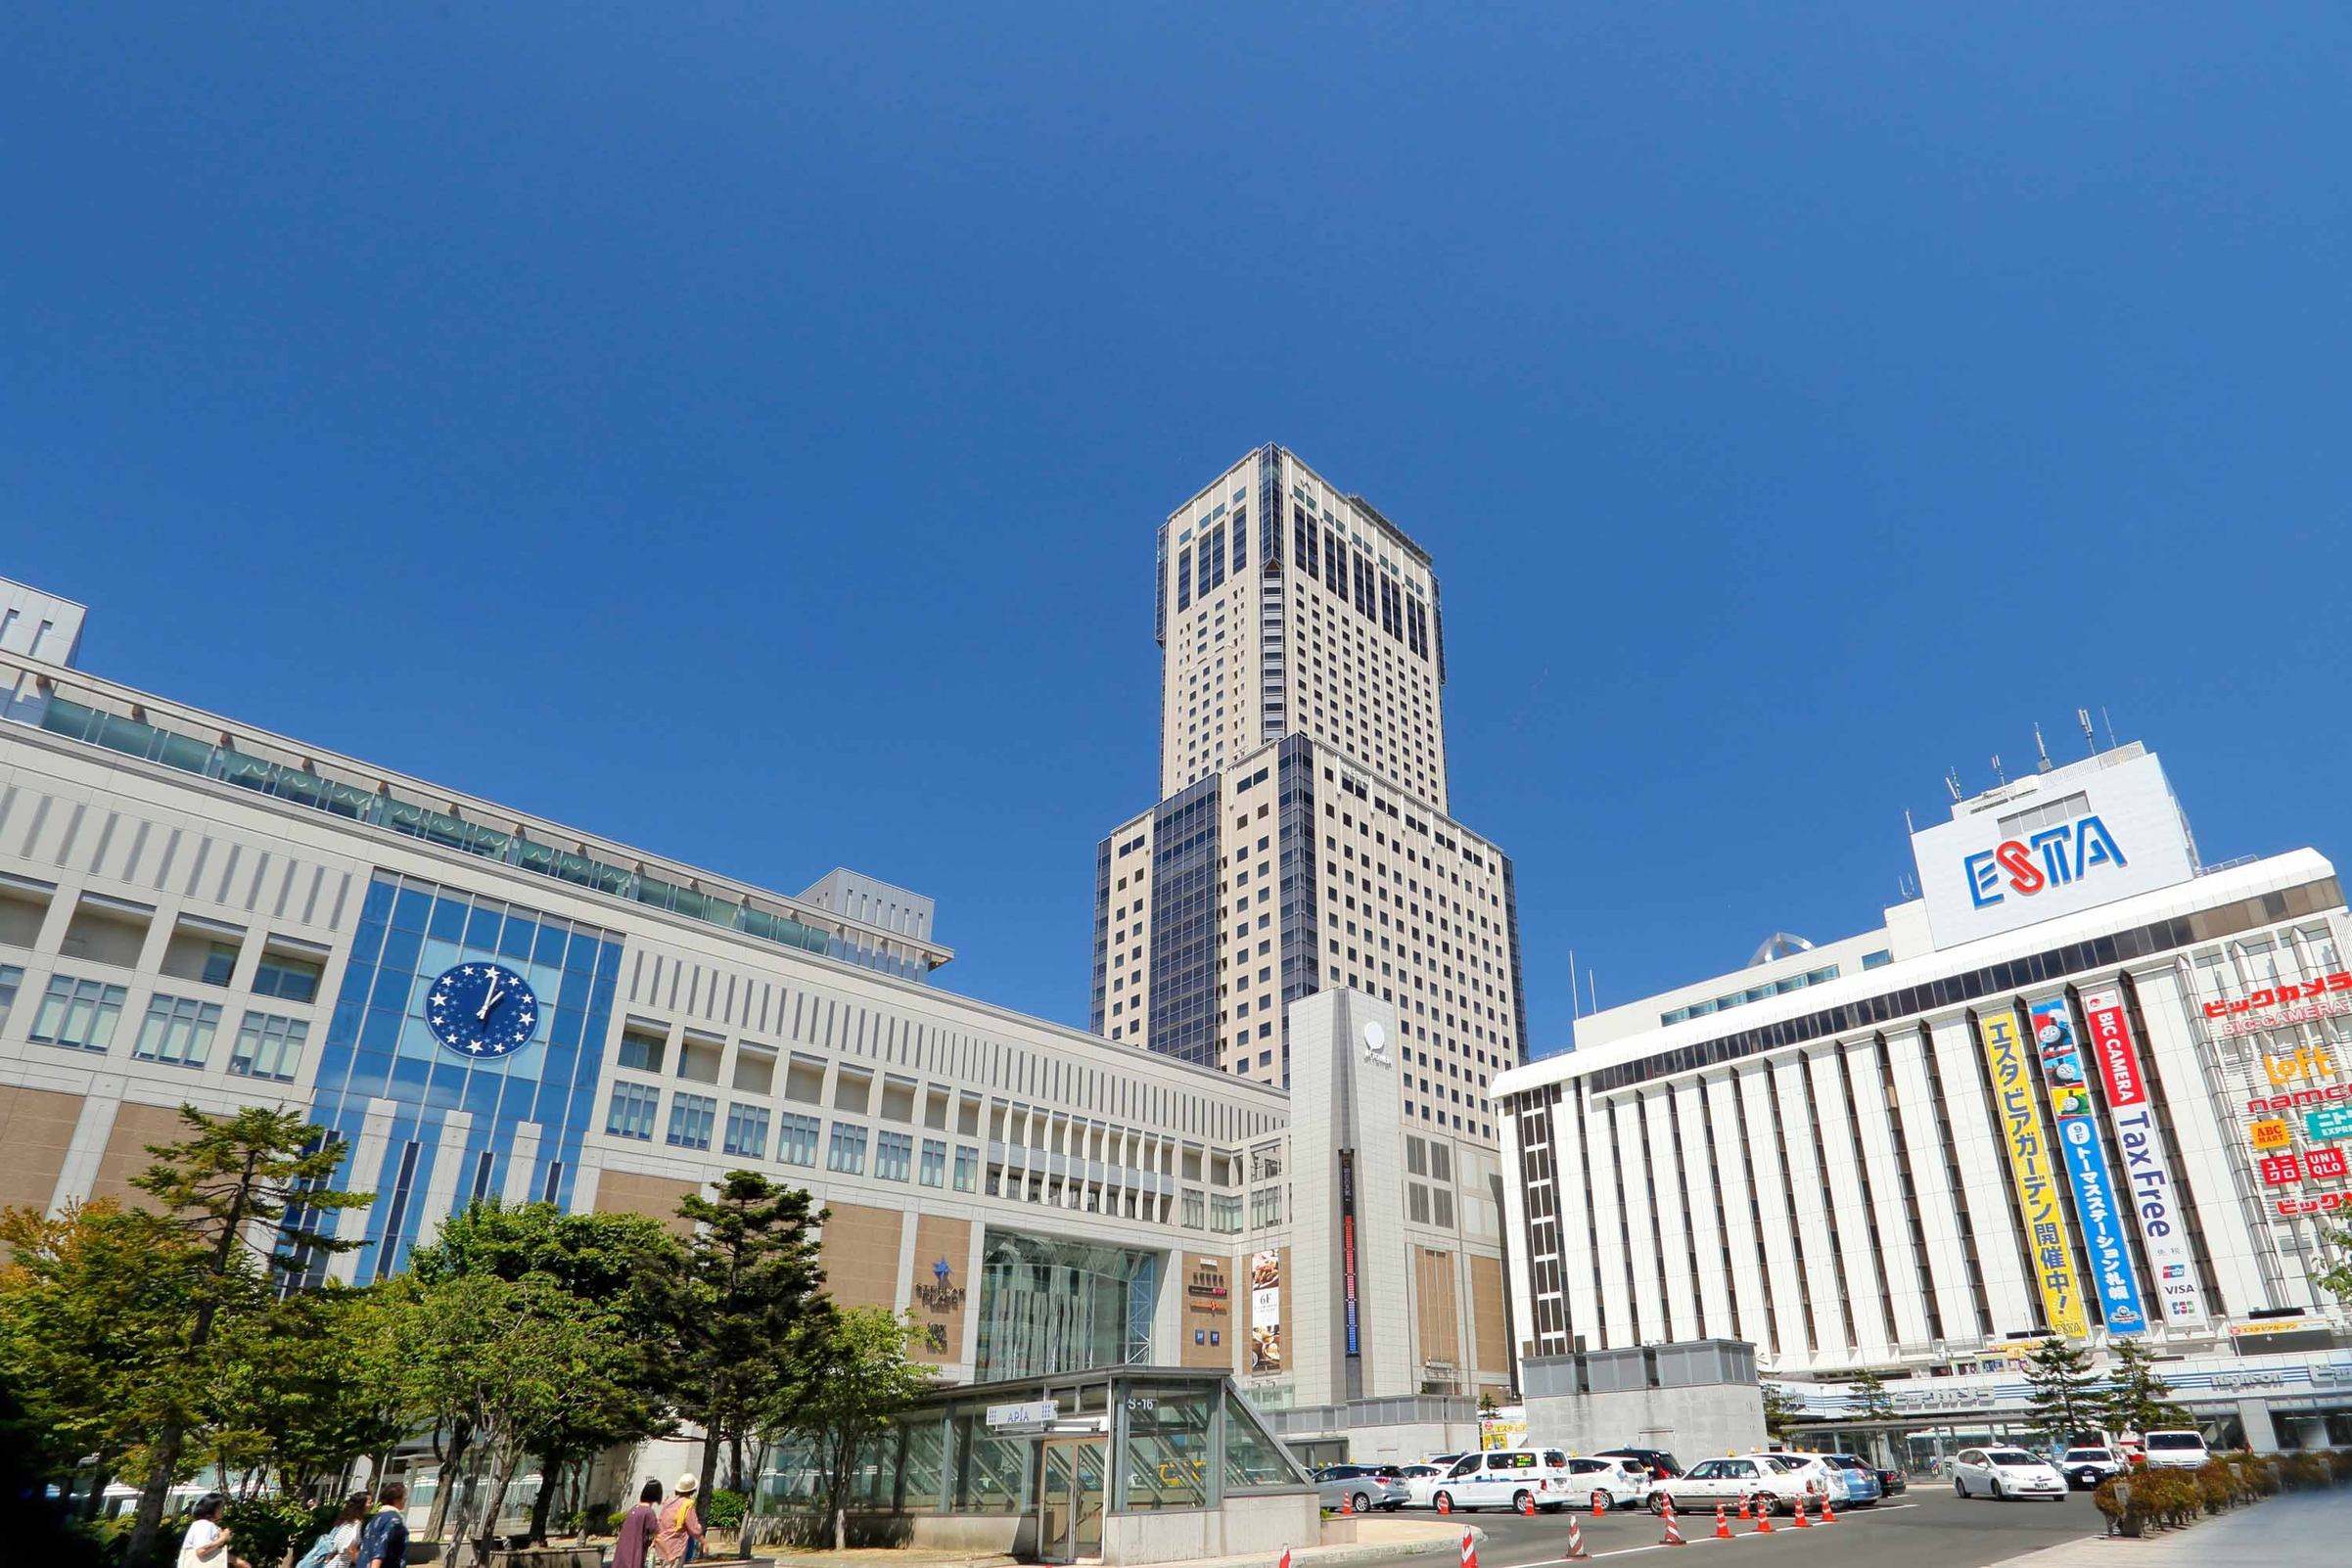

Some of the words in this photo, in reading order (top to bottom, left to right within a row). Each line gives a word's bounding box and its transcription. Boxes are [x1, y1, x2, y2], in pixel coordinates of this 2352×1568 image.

[1964, 815, 2128, 910] ESTA
[2203, 971, 2352, 1018] ビックカメラ
[2098, 1011, 2117, 1037] BIC
[2223, 1019, 2256, 1036] BIC
[2261, 999, 2348, 1027] CAMERA
[2105, 1038, 2135, 1102] CAMERA
[2247, 1084, 2352, 1113] namc
[2119, 1110, 2151, 1167] Tax
[2257, 1125, 2283, 1137] ABC
[2258, 1133, 2283, 1144] MART
[2267, 1159, 2292, 1172] ユニ
[2310, 1153, 2336, 1165] UNI
[2270, 1170, 2296, 1181] クロ
[2313, 1162, 2341, 1176] QLO
[2134, 1170, 2170, 1237] Free
[2164, 1284, 2195, 1294] VISA
[1128, 1399, 1153, 1410] S-16
[1007, 1407, 1030, 1423] APIA
